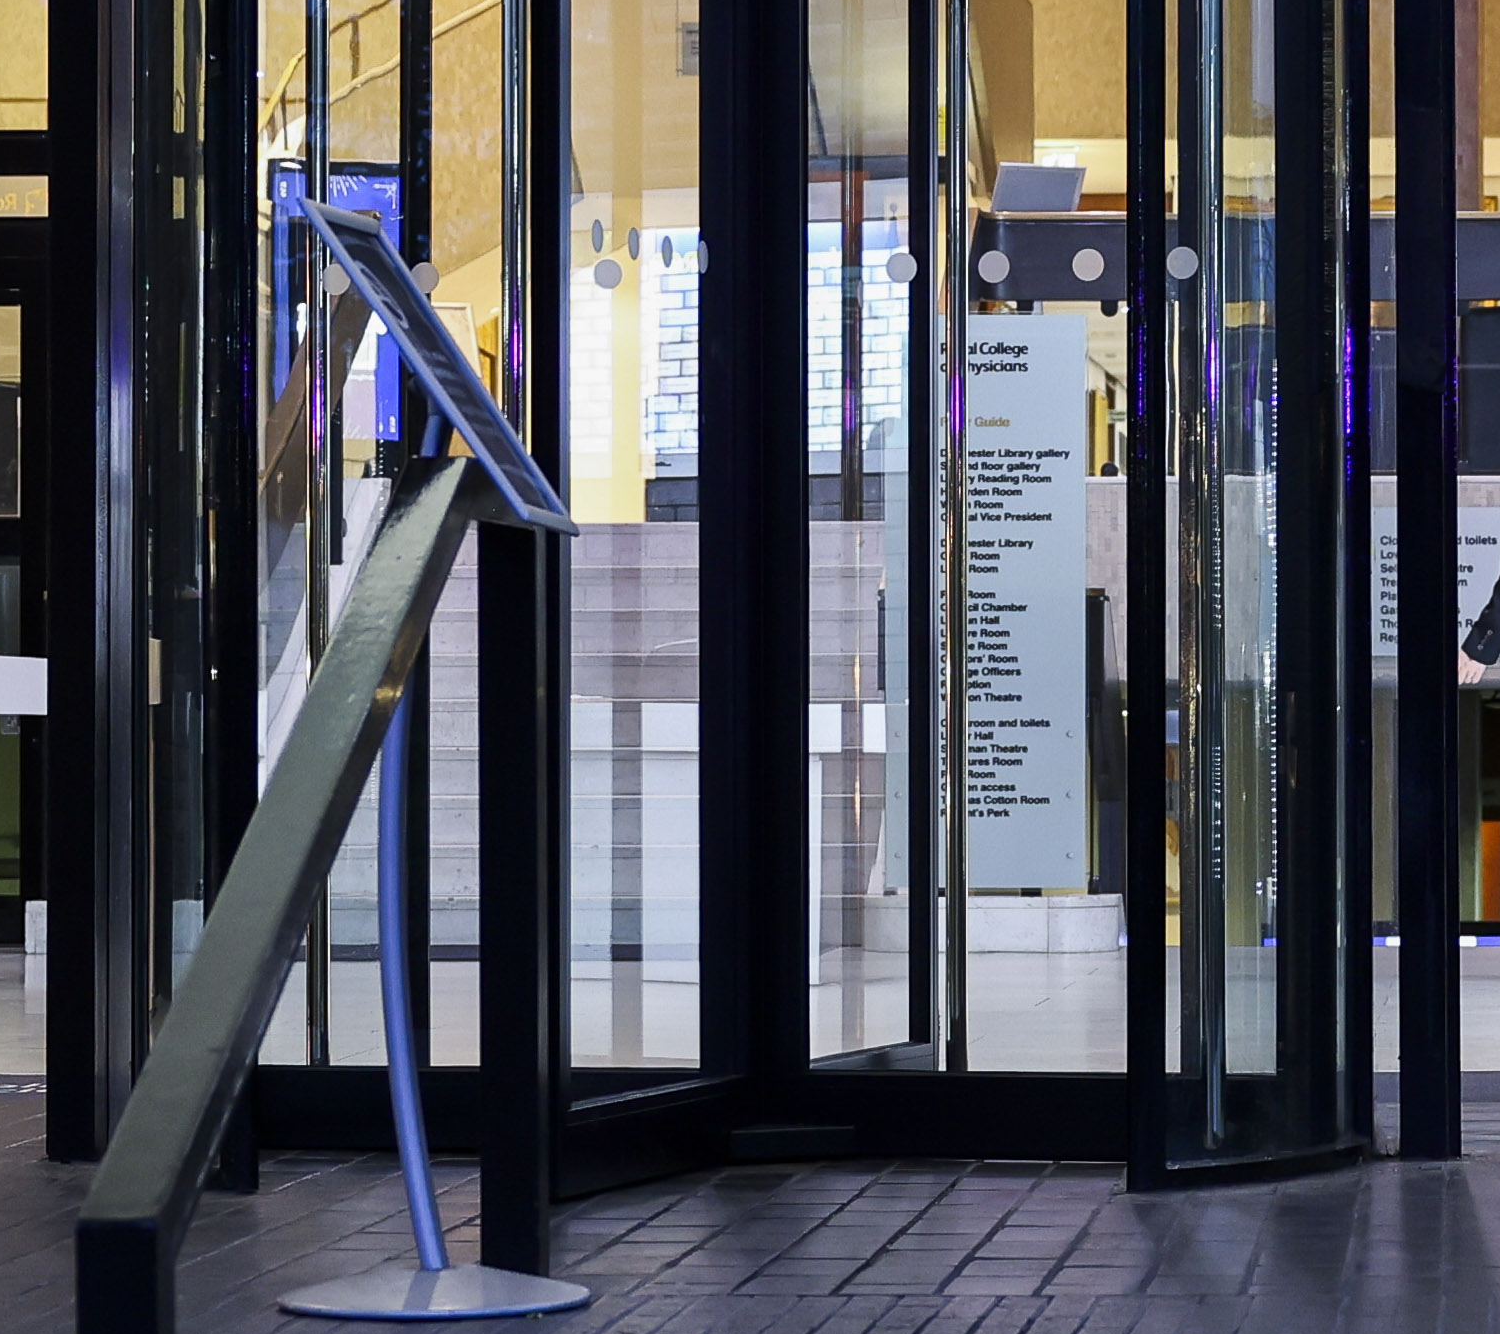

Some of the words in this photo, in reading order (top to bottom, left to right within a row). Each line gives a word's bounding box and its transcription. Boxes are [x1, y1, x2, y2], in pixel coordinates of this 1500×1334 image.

[940, 342, 977, 355] Ral
[979, 342, 1029, 358] College
[967, 359, 1029, 375] hysicians
[974, 416, 1010, 427] Guide
[998, 449, 1033, 460] Library
[1036, 449, 1070, 460] gallery
[981, 461, 1004, 471] floor
[1006, 461, 1041, 473] gallery
[978, 474, 1020, 485] Reading
[1022, 474, 1052, 483] Room
[992, 488, 1023, 497] Room
[974, 500, 1004, 509] Room
[980, 513, 1002, 522] Vice
[1004, 513, 1052, 522] President
[998, 539, 1033, 550] Library
[1465, 535, 1498, 546] toilets
[970, 551, 1000, 560] Room
[969, 565, 999, 574] Room
[967, 590, 996, 599] Room
[981, 603, 1028, 612] Chamber
[980, 616, 1000, 625] Hall
[980, 629, 1010, 638] Room
[978, 642, 1008, 650] Room
[988, 654, 1018, 664] Room
[981, 667, 1022, 676] Officers
[985, 693, 1022, 702] Theatre
[998, 719, 1018, 728] and
[1020, 719, 1051, 728] toilets
[974, 732, 994, 741] Hall
[990, 744, 1028, 753] Theatre
[992, 757, 1023, 766] Room
[967, 770, 996, 779] Room
[980, 784, 1016, 792] access
[984, 795, 1018, 805] Cotton
[1020, 796, 1050, 805] Room
